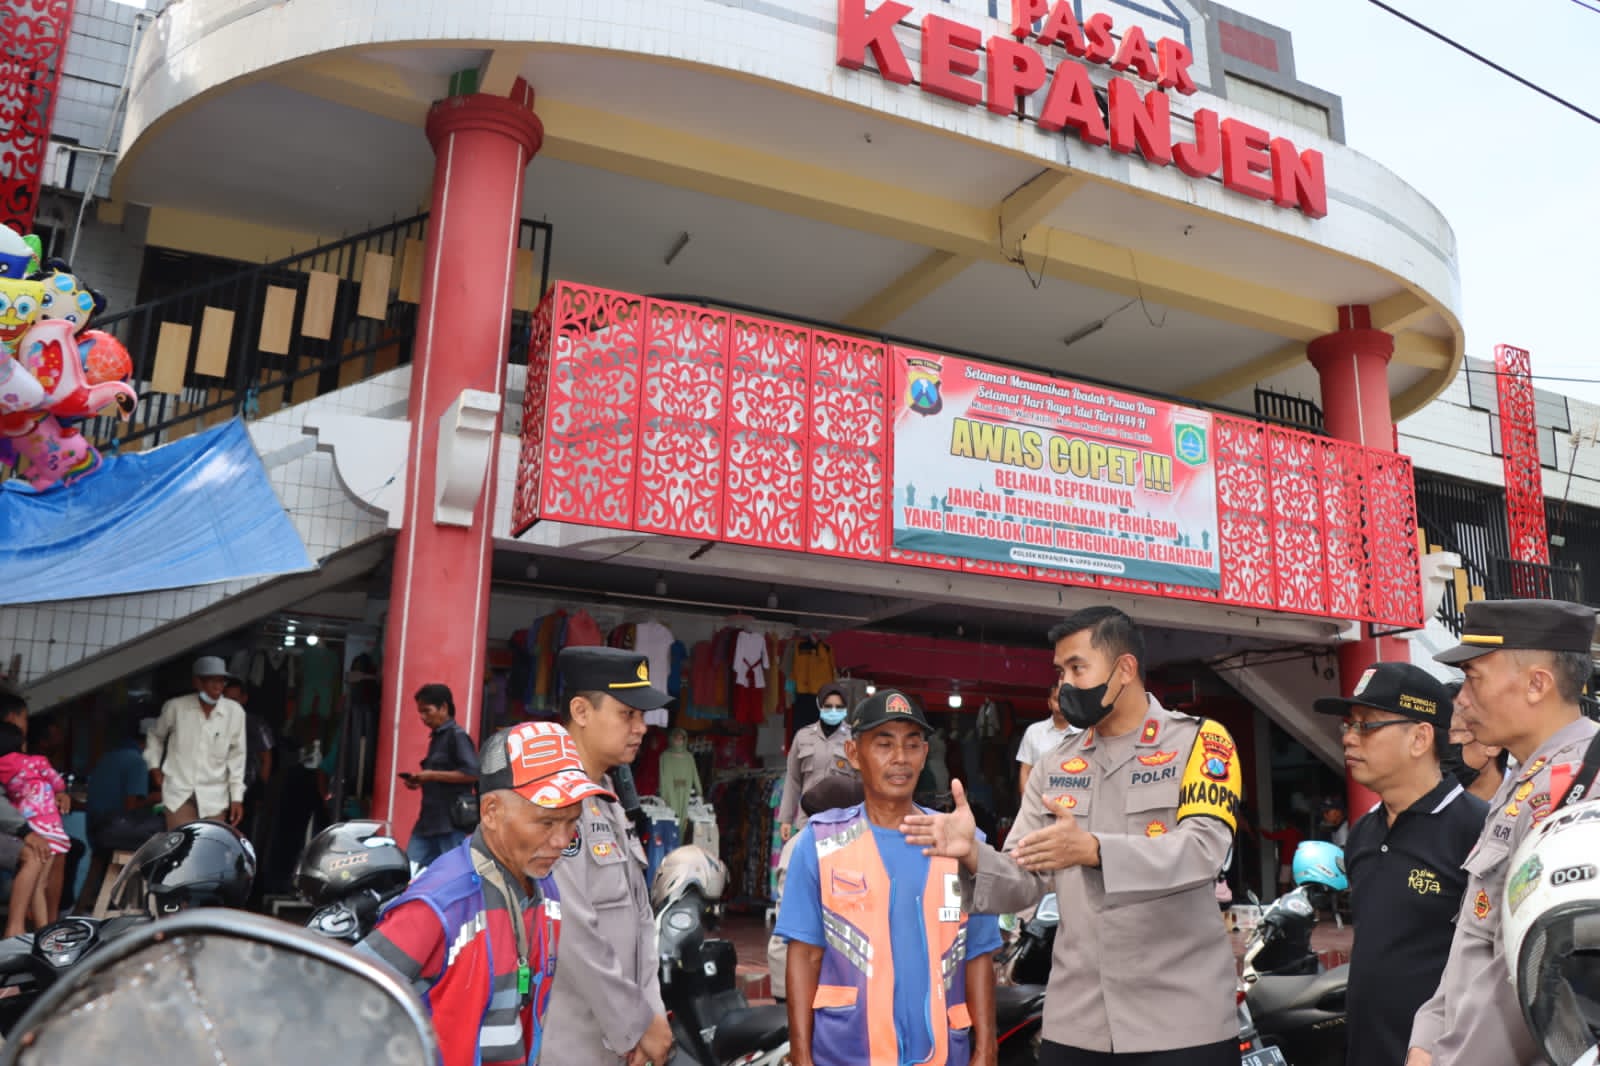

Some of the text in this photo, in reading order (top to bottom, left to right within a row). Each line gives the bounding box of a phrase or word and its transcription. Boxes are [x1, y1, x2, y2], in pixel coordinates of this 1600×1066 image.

[1011, 0, 1197, 95] PASAR
[836, 0, 1327, 220] KEPANJEN
[965, 367, 1007, 385] Selamat
[1107, 396, 1136, 412] Puasa
[1138, 402, 1156, 416] Dan
[978, 385, 1147, 430] Selamat Hari Raya Idul Fitri 1444 H
[951, 417, 1172, 492] AWAS COPET !!!
[995, 469, 1051, 496] BELANJA
[946, 487, 1177, 538] JANGAN MENGGUNAKAN PERHIASAN
[904, 506, 1214, 569] YANG MENCOLOK DAN MENGUNDANG KEJAHATAN
[1049, 775, 1092, 788] WISNU
[1131, 766, 1176, 785] POLRI
[1554, 866, 1592, 884] DOT
